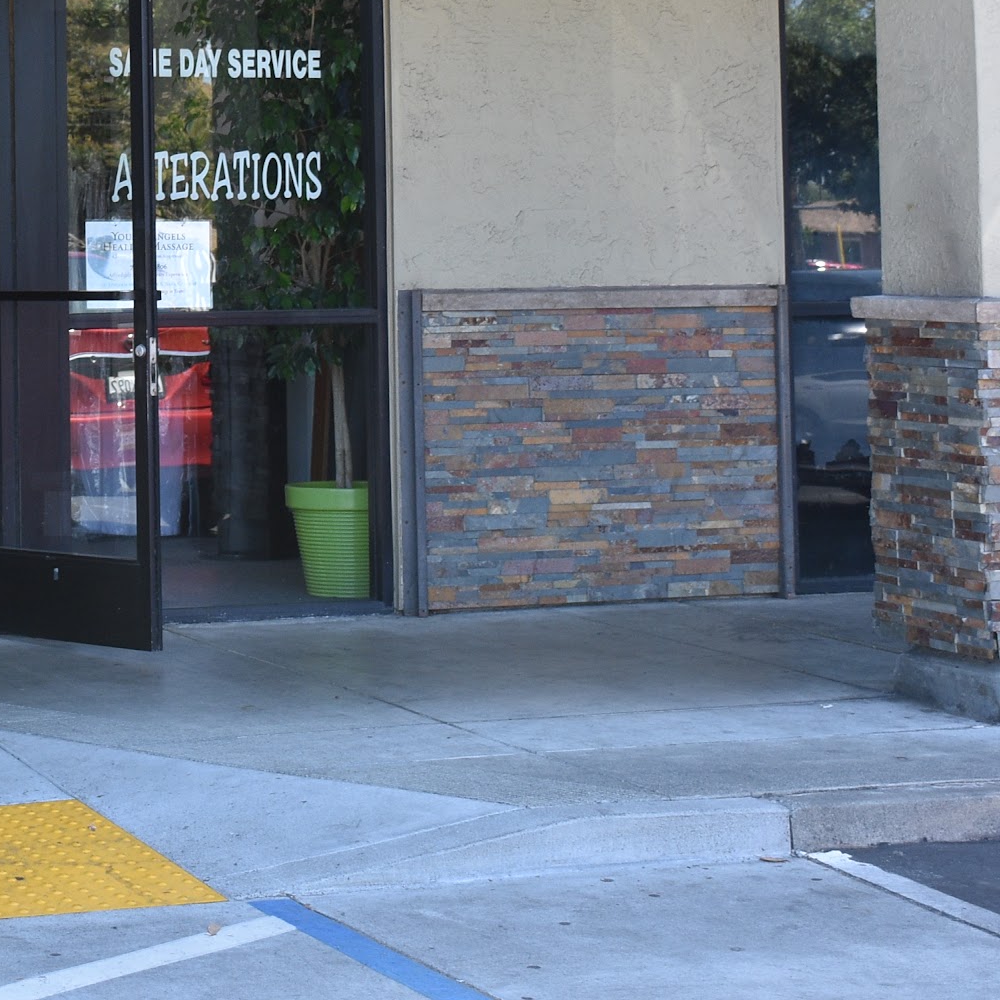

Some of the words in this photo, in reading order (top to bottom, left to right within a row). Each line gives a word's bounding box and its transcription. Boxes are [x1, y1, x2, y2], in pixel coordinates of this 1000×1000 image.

[109, 47, 173, 78] SAE
[179, 48, 222, 78] DAY
[227, 49, 322, 79] SERVICE
[111, 150, 323, 203] ATERATIONS
[157, 232, 186, 240] NGELS
